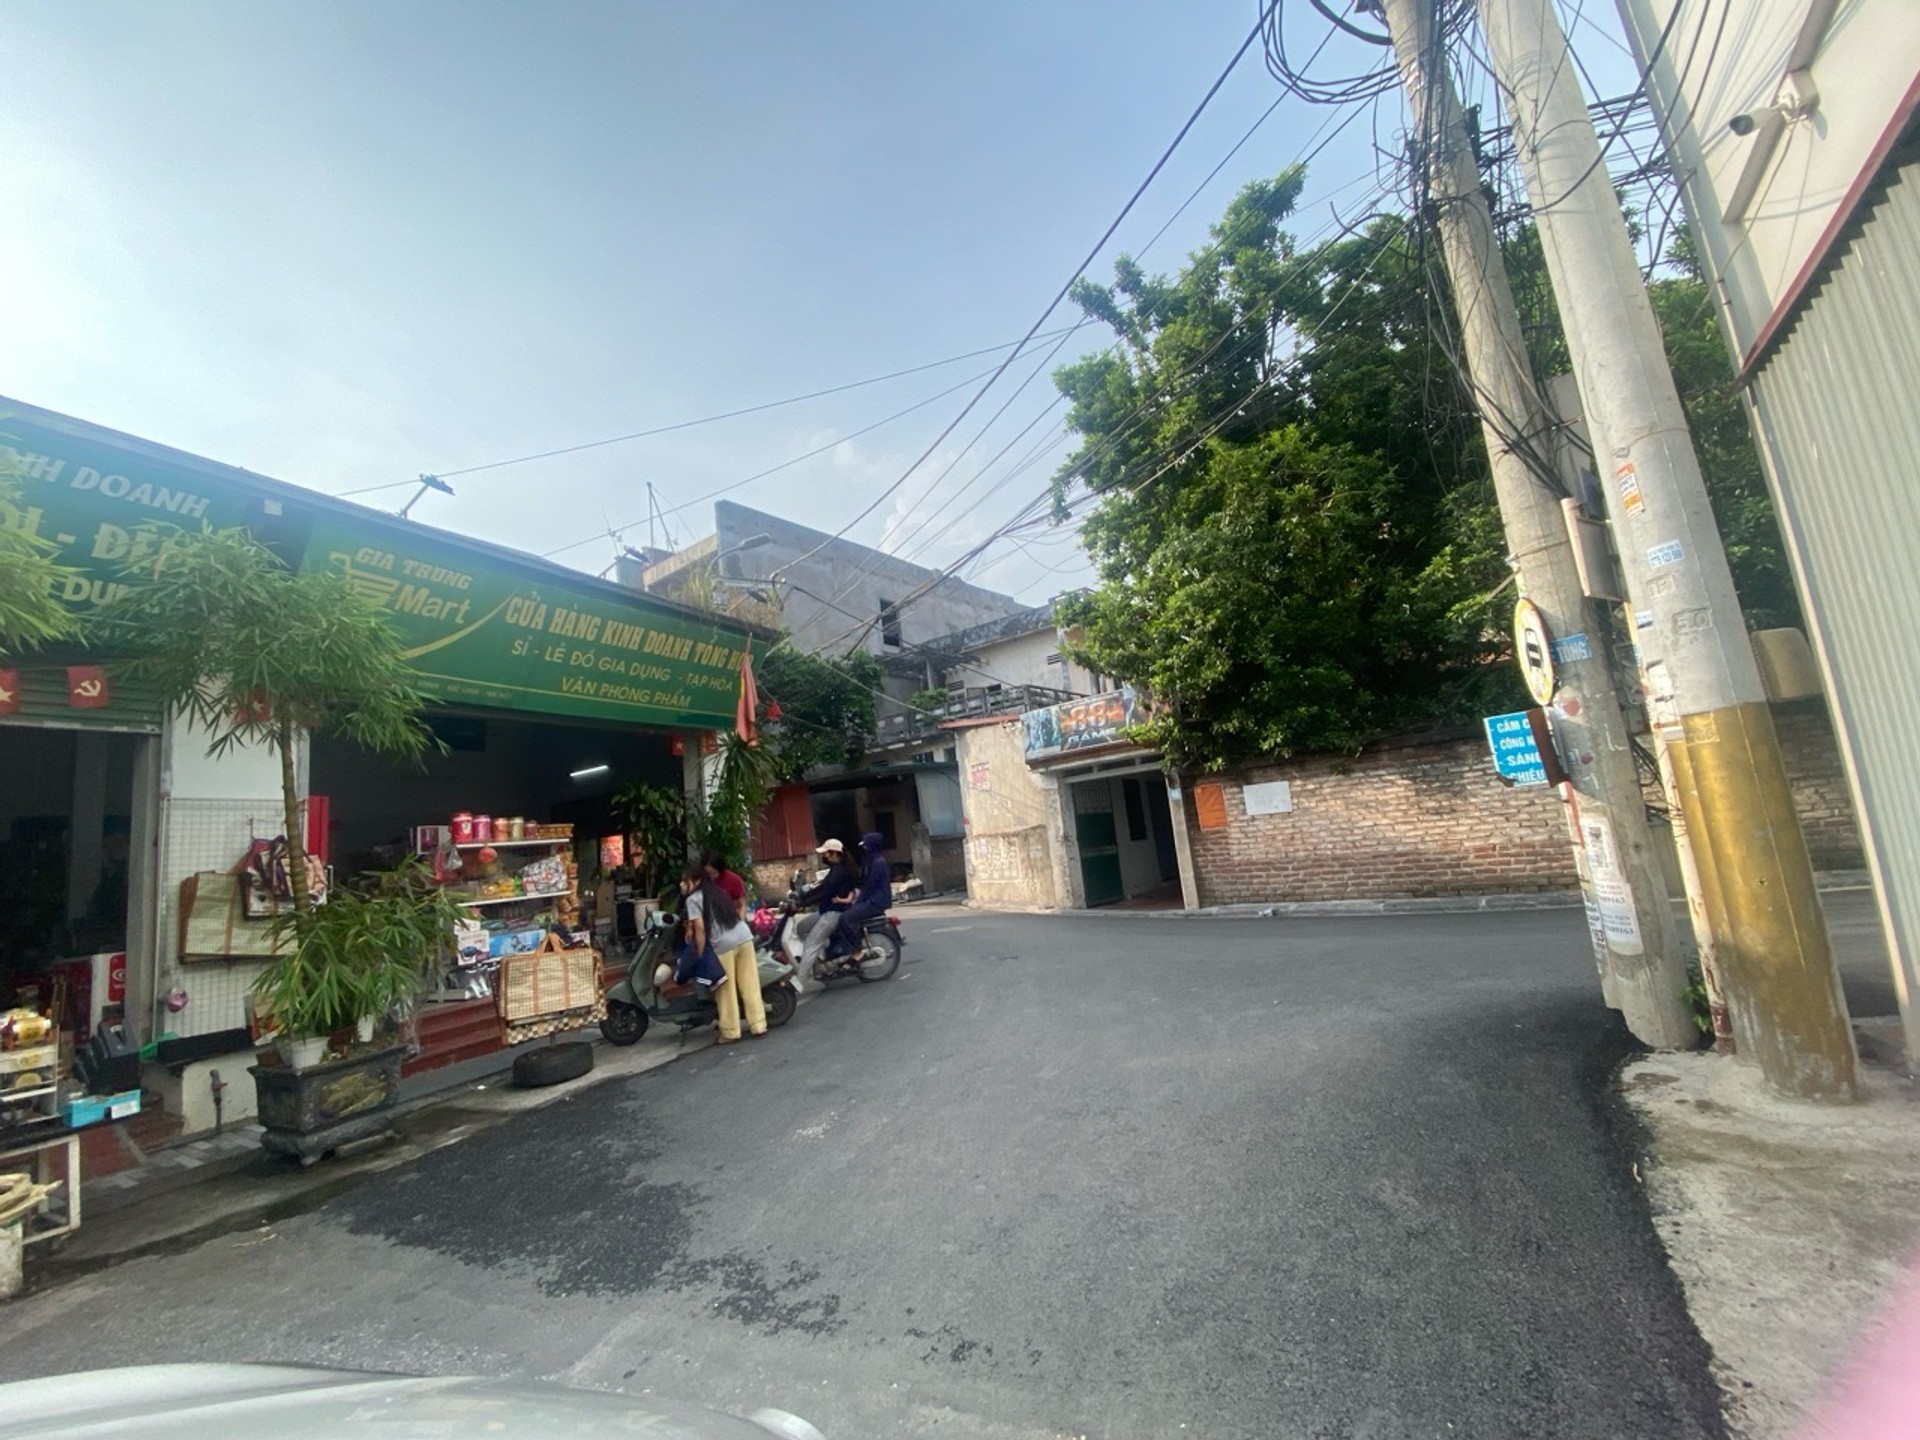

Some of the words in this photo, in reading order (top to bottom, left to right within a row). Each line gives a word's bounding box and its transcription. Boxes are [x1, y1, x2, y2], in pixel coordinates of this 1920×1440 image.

[70, 466, 210, 518] DOANH
[356, 547, 396, 570] GIA
[402, 558, 473, 590] TRUNG
[395, 584, 471, 624] Mart
[506, 590, 545, 630] CỬA
[549, 603, 602, 641] HÀNG
[601, 619, 645, 650] KINH
[643, 630, 696, 662] DOANH
[693, 634, 730, 669] TỔNG
[599, 656, 626, 674] GIA
[629, 661, 672, 682] DỤNG
